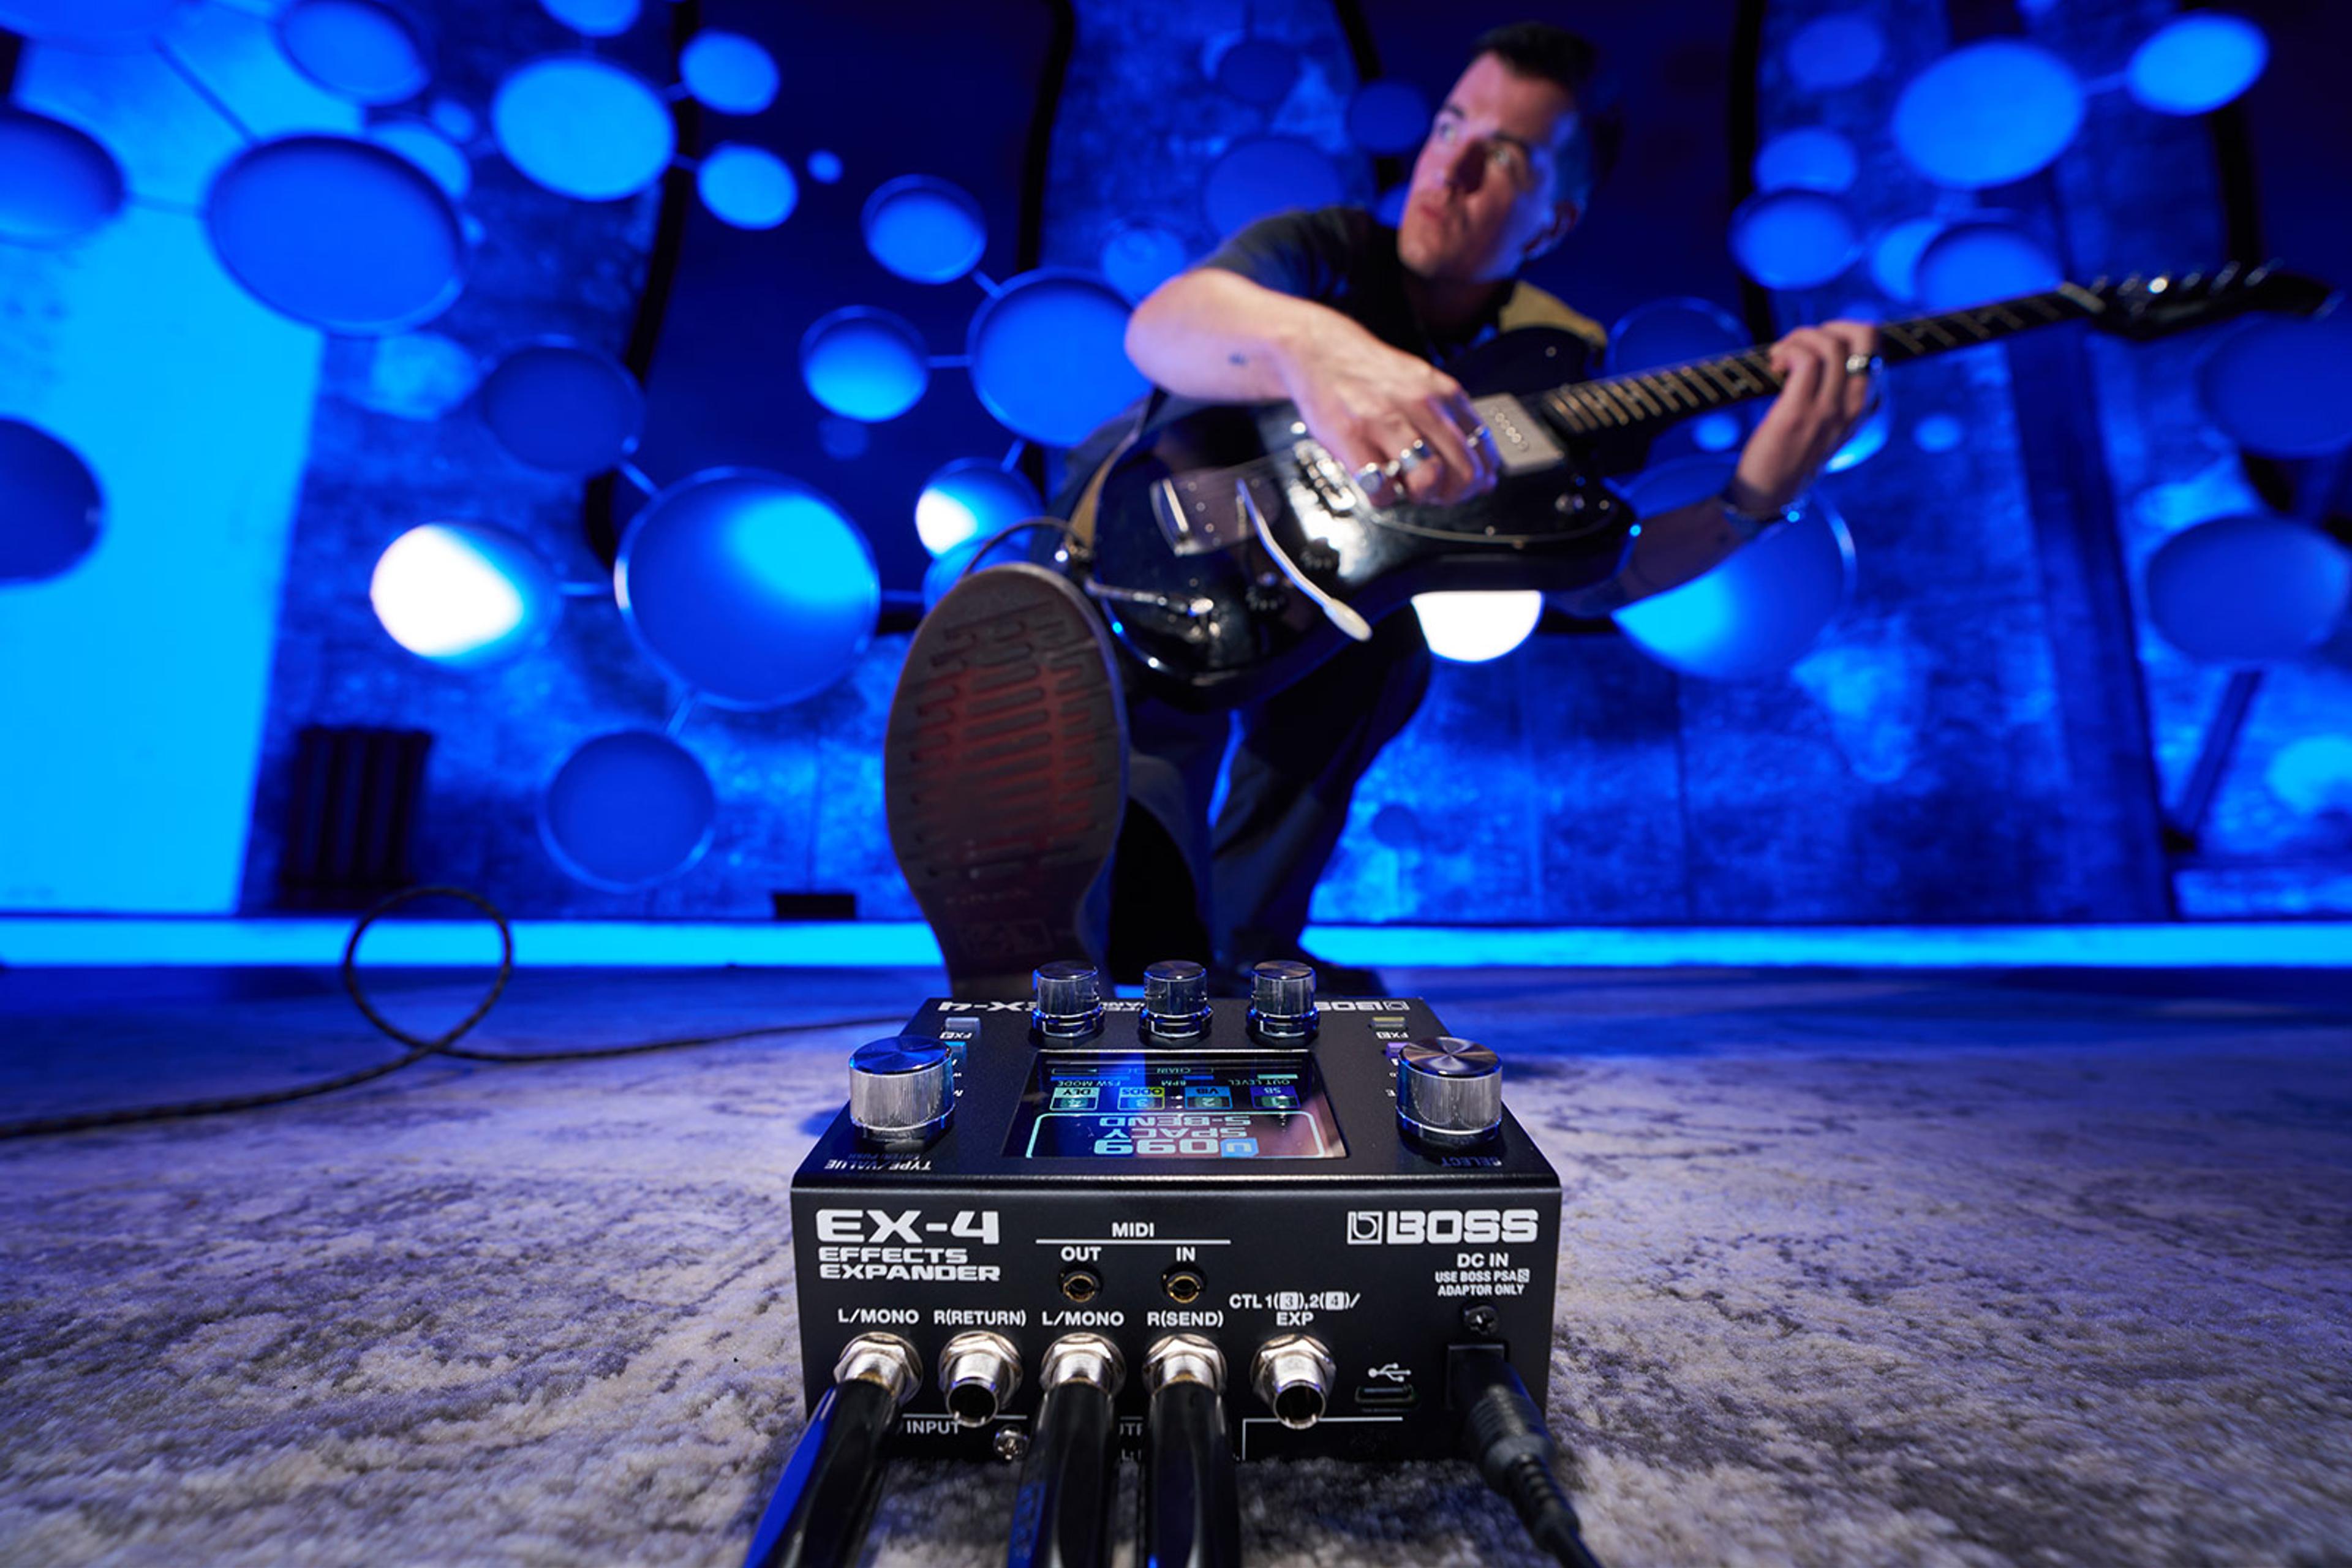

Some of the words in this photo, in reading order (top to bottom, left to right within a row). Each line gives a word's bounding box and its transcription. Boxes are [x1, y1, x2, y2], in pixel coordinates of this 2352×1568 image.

[1314, 1001, 1384, 1011] BOS
[1202, 1098, 1215, 1107] 2
[1099, 1116, 1251, 1126] S-BEND
[1104, 1127, 1248, 1138] SPACY
[1442, 1156, 1502, 1166] SELECT
[816, 1209, 1000, 1244] EX-4
[1112, 1222, 1155, 1237] MIDI
[1387, 1209, 1539, 1244] BOSS
[819, 1246, 968, 1264] EFFECTS
[1061, 1246, 1101, 1262] OUT
[1175, 1246, 1196, 1262] IN
[1457, 1253, 1485, 1268] DC
[1489, 1253, 1509, 1267] IN
[820, 1264, 1001, 1281] EXPANDER
[1434, 1270, 1458, 1283] USE
[1460, 1270, 1491, 1283] BOSS
[1438, 1284, 1493, 1296] ADAPTOR
[1494, 1283, 1525, 1296] ONLY
[1229, 1294, 1262, 1309] CTL
[838, 1308, 919, 1324] L/MONO
[933, 1310, 1027, 1326] R(RETURN)
[1042, 1311, 1125, 1326] L/MONO
[1147, 1310, 1224, 1328] R(SEND)
[1276, 1311, 1314, 1326] EXP
[907, 1420, 962, 1434] INPUT
